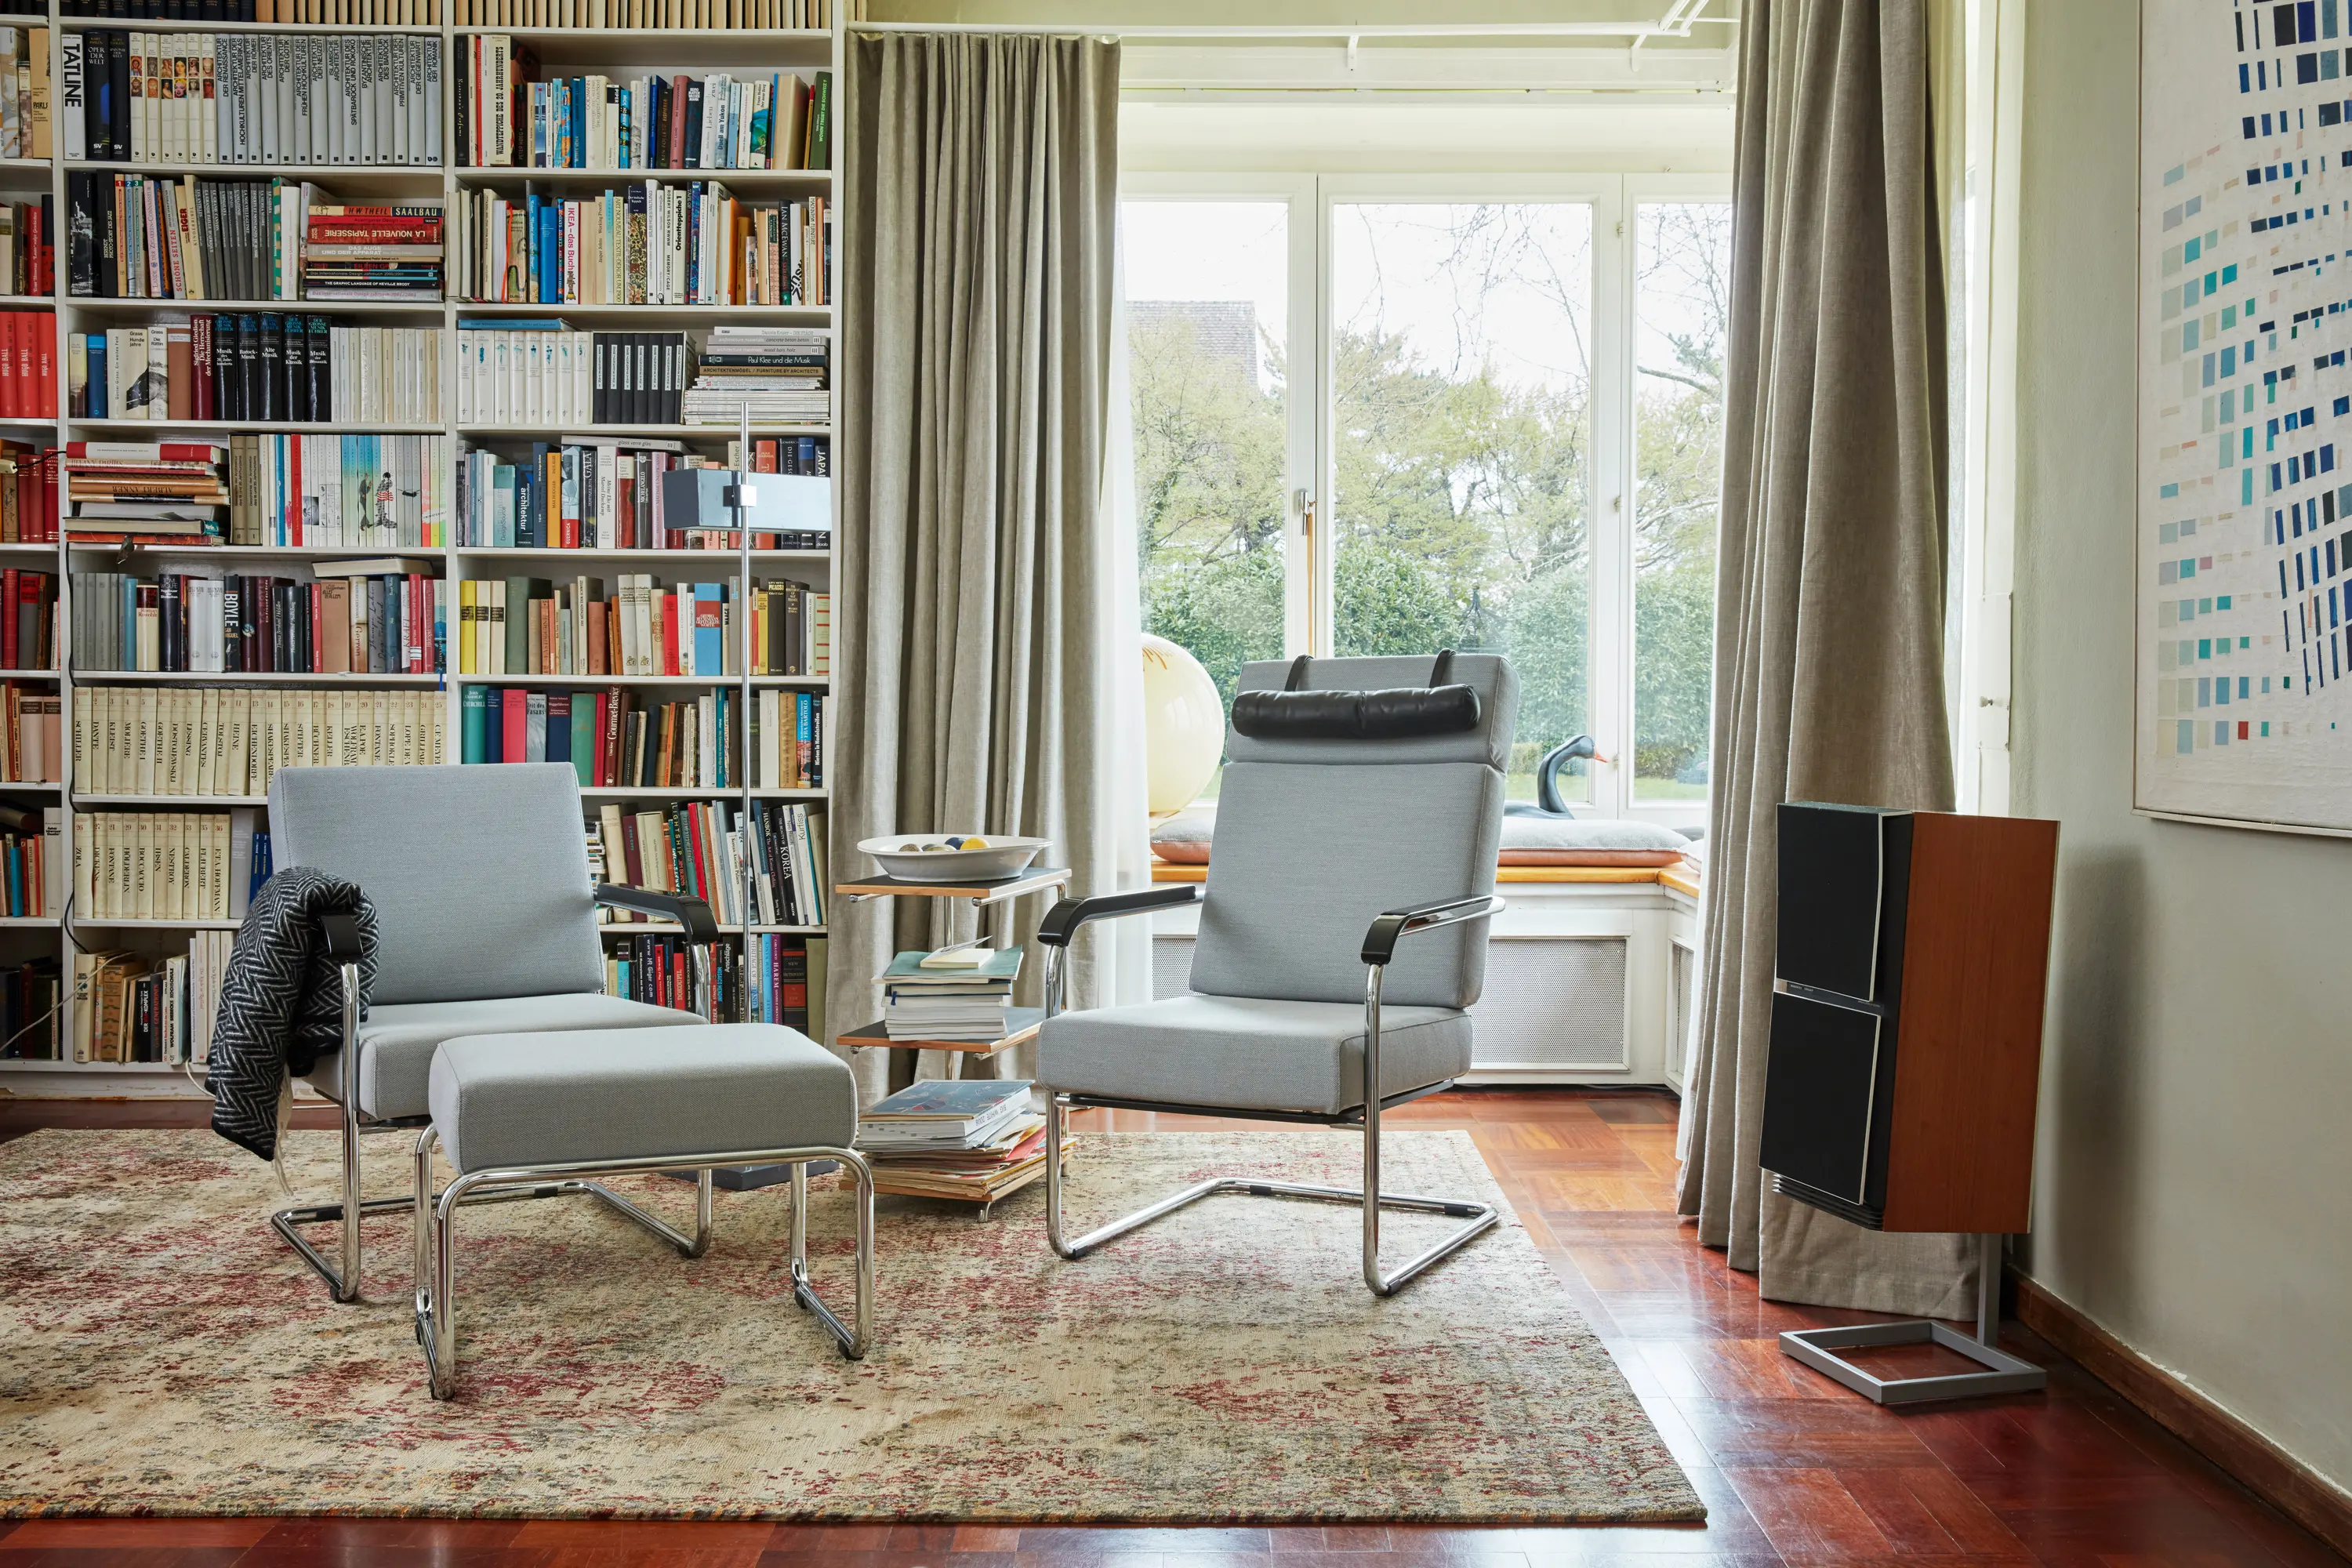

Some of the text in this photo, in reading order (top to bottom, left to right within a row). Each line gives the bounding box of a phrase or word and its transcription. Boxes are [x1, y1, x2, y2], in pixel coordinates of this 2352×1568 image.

[64, 44, 82, 107] TATLINE
[495, 46, 503, 91] JAHRHUNDERTS
[495, 114, 504, 155] WANDTEPPICHE
[719, 125, 724, 133] am
[180, 208, 189, 232] EIGER
[396, 208, 437, 216] SAALBAU
[169, 229, 183, 292] SCHÖNE SEITEN
[224, 593, 238, 627] BOYLE
[354, 626, 363, 656] Gerron
[607, 686, 619, 740] Gourmet-Brevier
[123, 721, 132, 759] MOLIÈRE
[169, 723, 178, 782] DOSTOJEWSKIJ
[200, 722, 209, 768] CERVANTES
[216, 723, 225, 757] TOLSTOJ
[231, 723, 240, 750] HEINE
[405, 748, 411, 760] DE
[672, 805, 681, 855] LIGHTSHIP
[975, 1116, 985, 1126] 2008
[987, 1109, 998, 1120] WHITE
